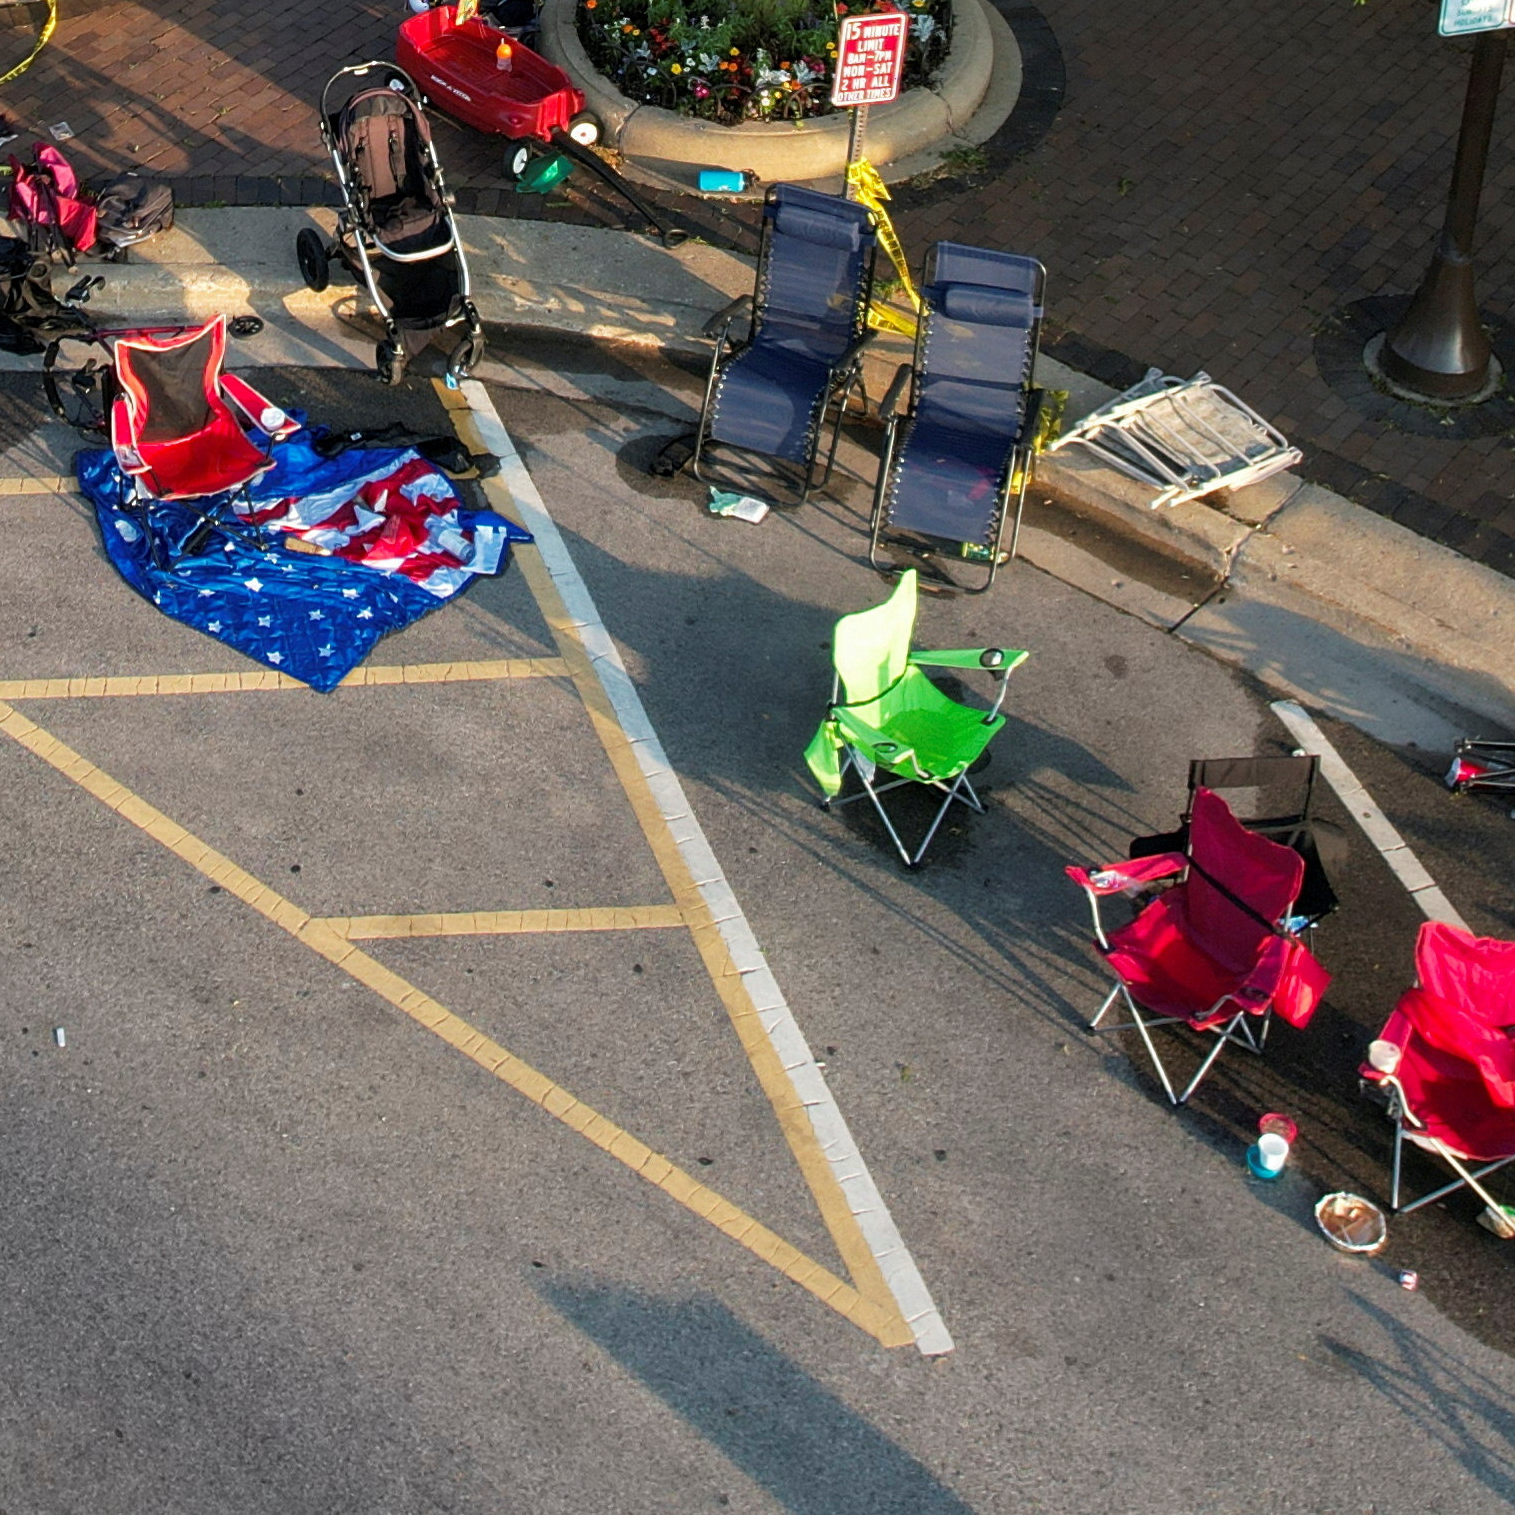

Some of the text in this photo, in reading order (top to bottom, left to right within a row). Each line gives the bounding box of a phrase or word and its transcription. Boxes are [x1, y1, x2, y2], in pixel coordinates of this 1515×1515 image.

[846, 22, 900, 40] 15 MINUTE
[857, 38, 884, 52] LIMIT
[841, 76, 890, 90] 2 HR ALL
[837, 87, 892, 101] OTHER TIMES
